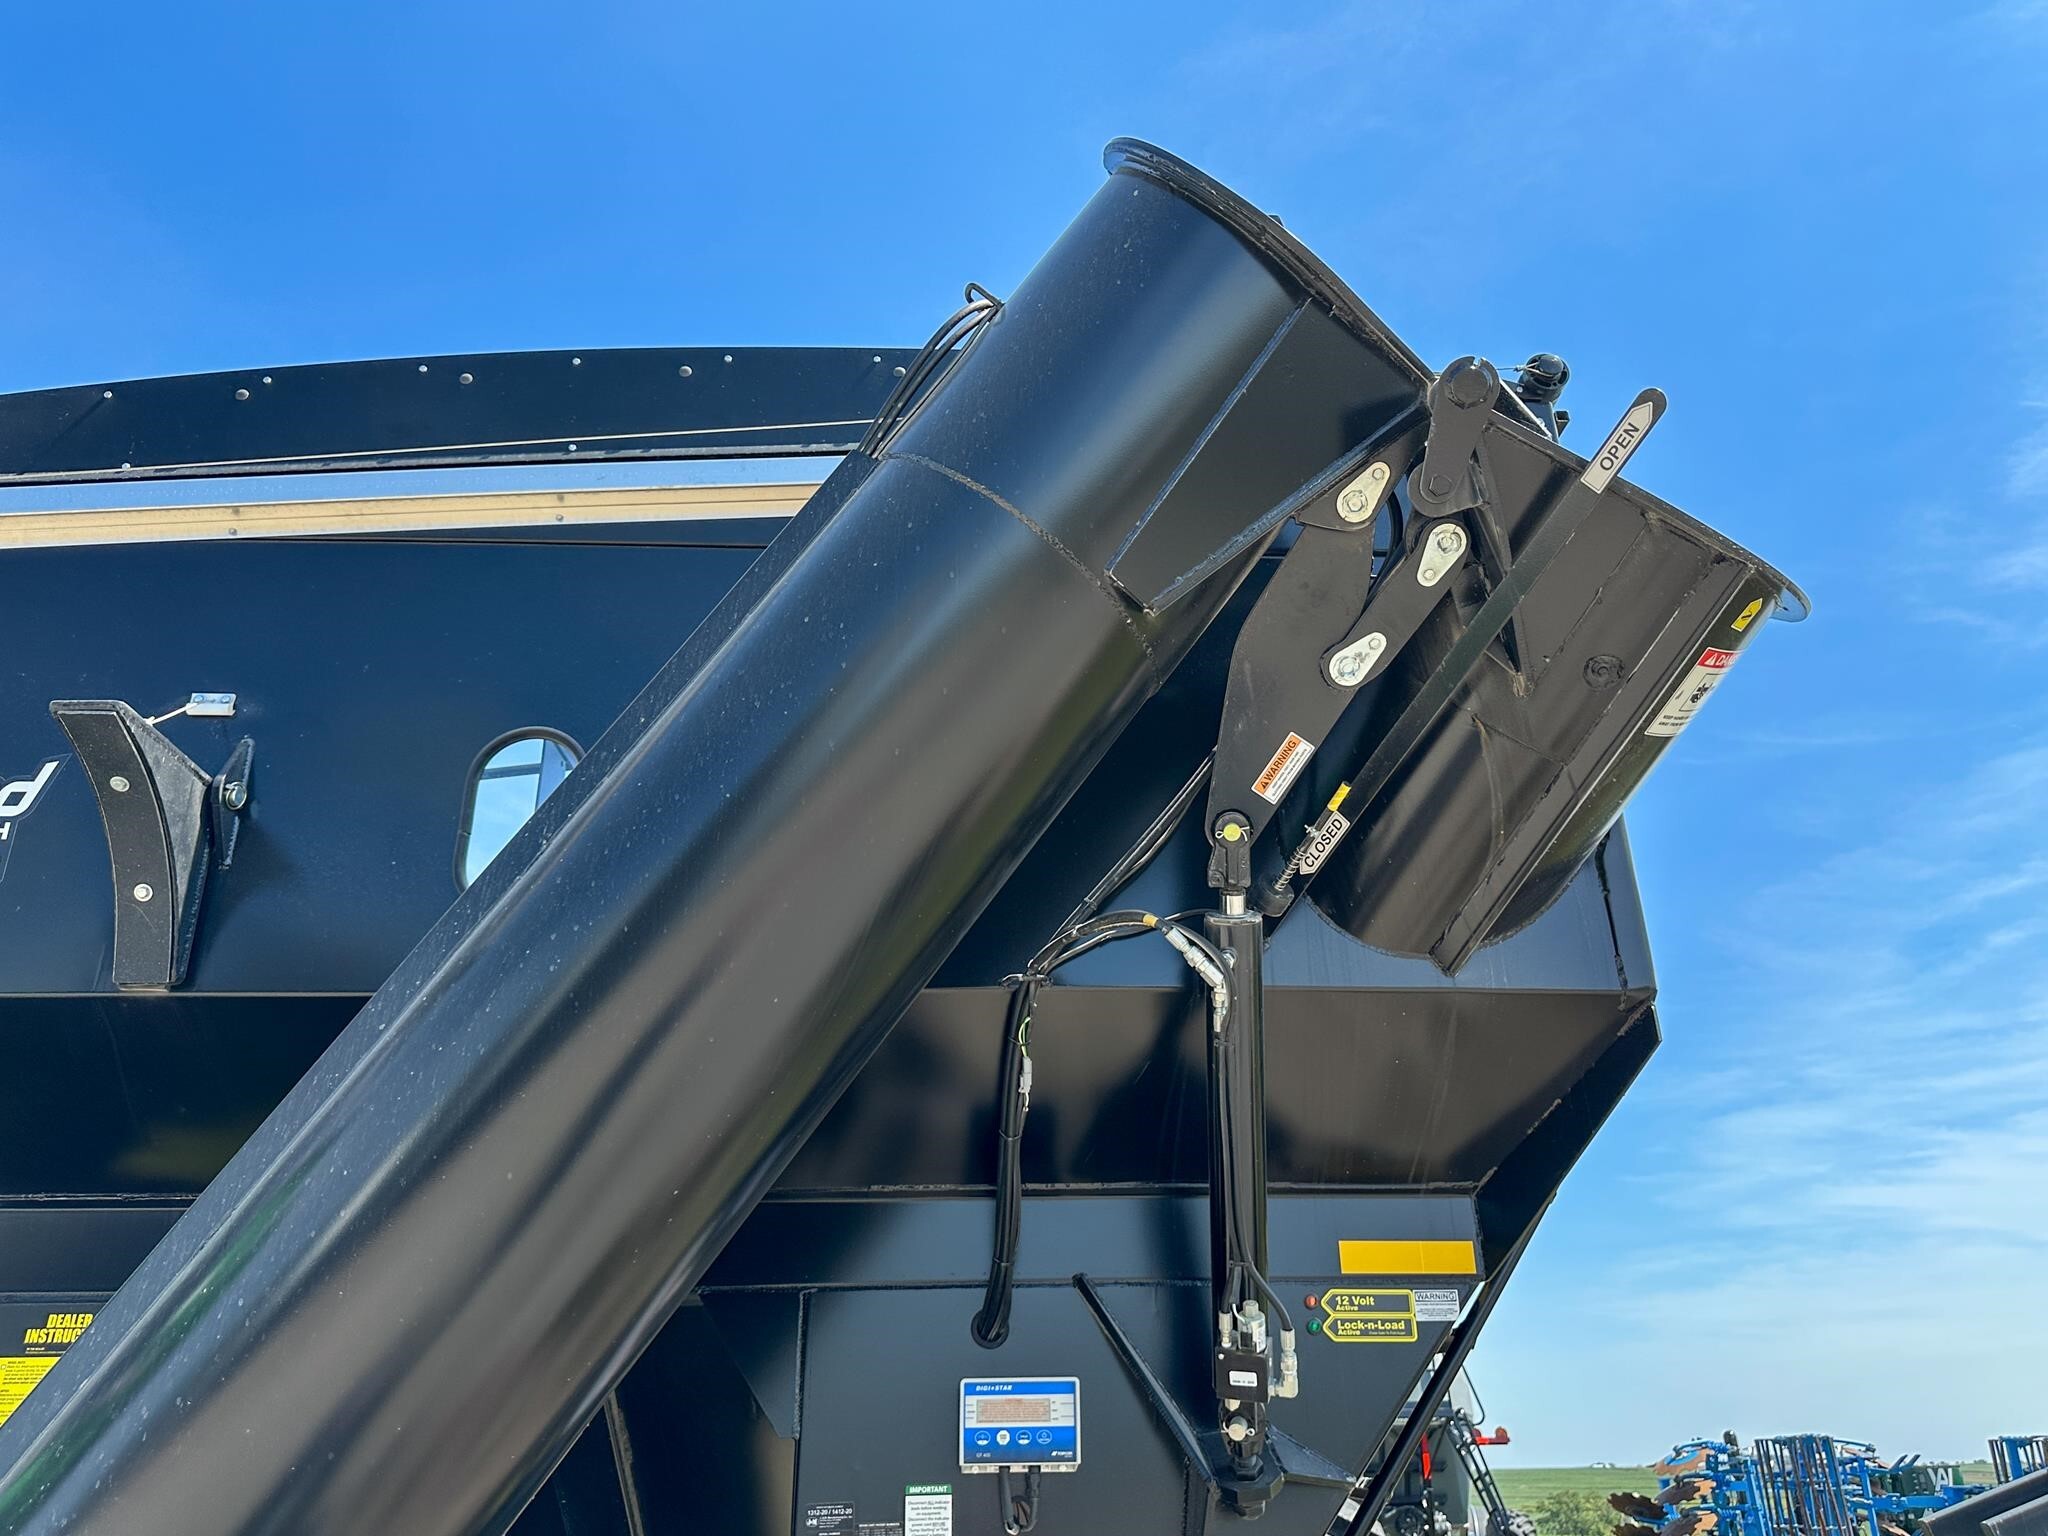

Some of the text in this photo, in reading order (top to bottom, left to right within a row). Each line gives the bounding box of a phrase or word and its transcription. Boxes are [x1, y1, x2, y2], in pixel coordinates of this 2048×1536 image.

[1600, 422, 1640, 471] OPEN
[1264, 740, 1297, 784] WARNING
[1304, 818, 1343, 868] CLOSED
[1336, 1295, 1375, 1306] 12 Volt
[1416, 1291, 1456, 1300] WARNING
[46, 1313, 94, 1328] DEALER
[24, 1328, 85, 1344] INSTRUC
[909, 1485, 948, 1494] IMPORTANT
